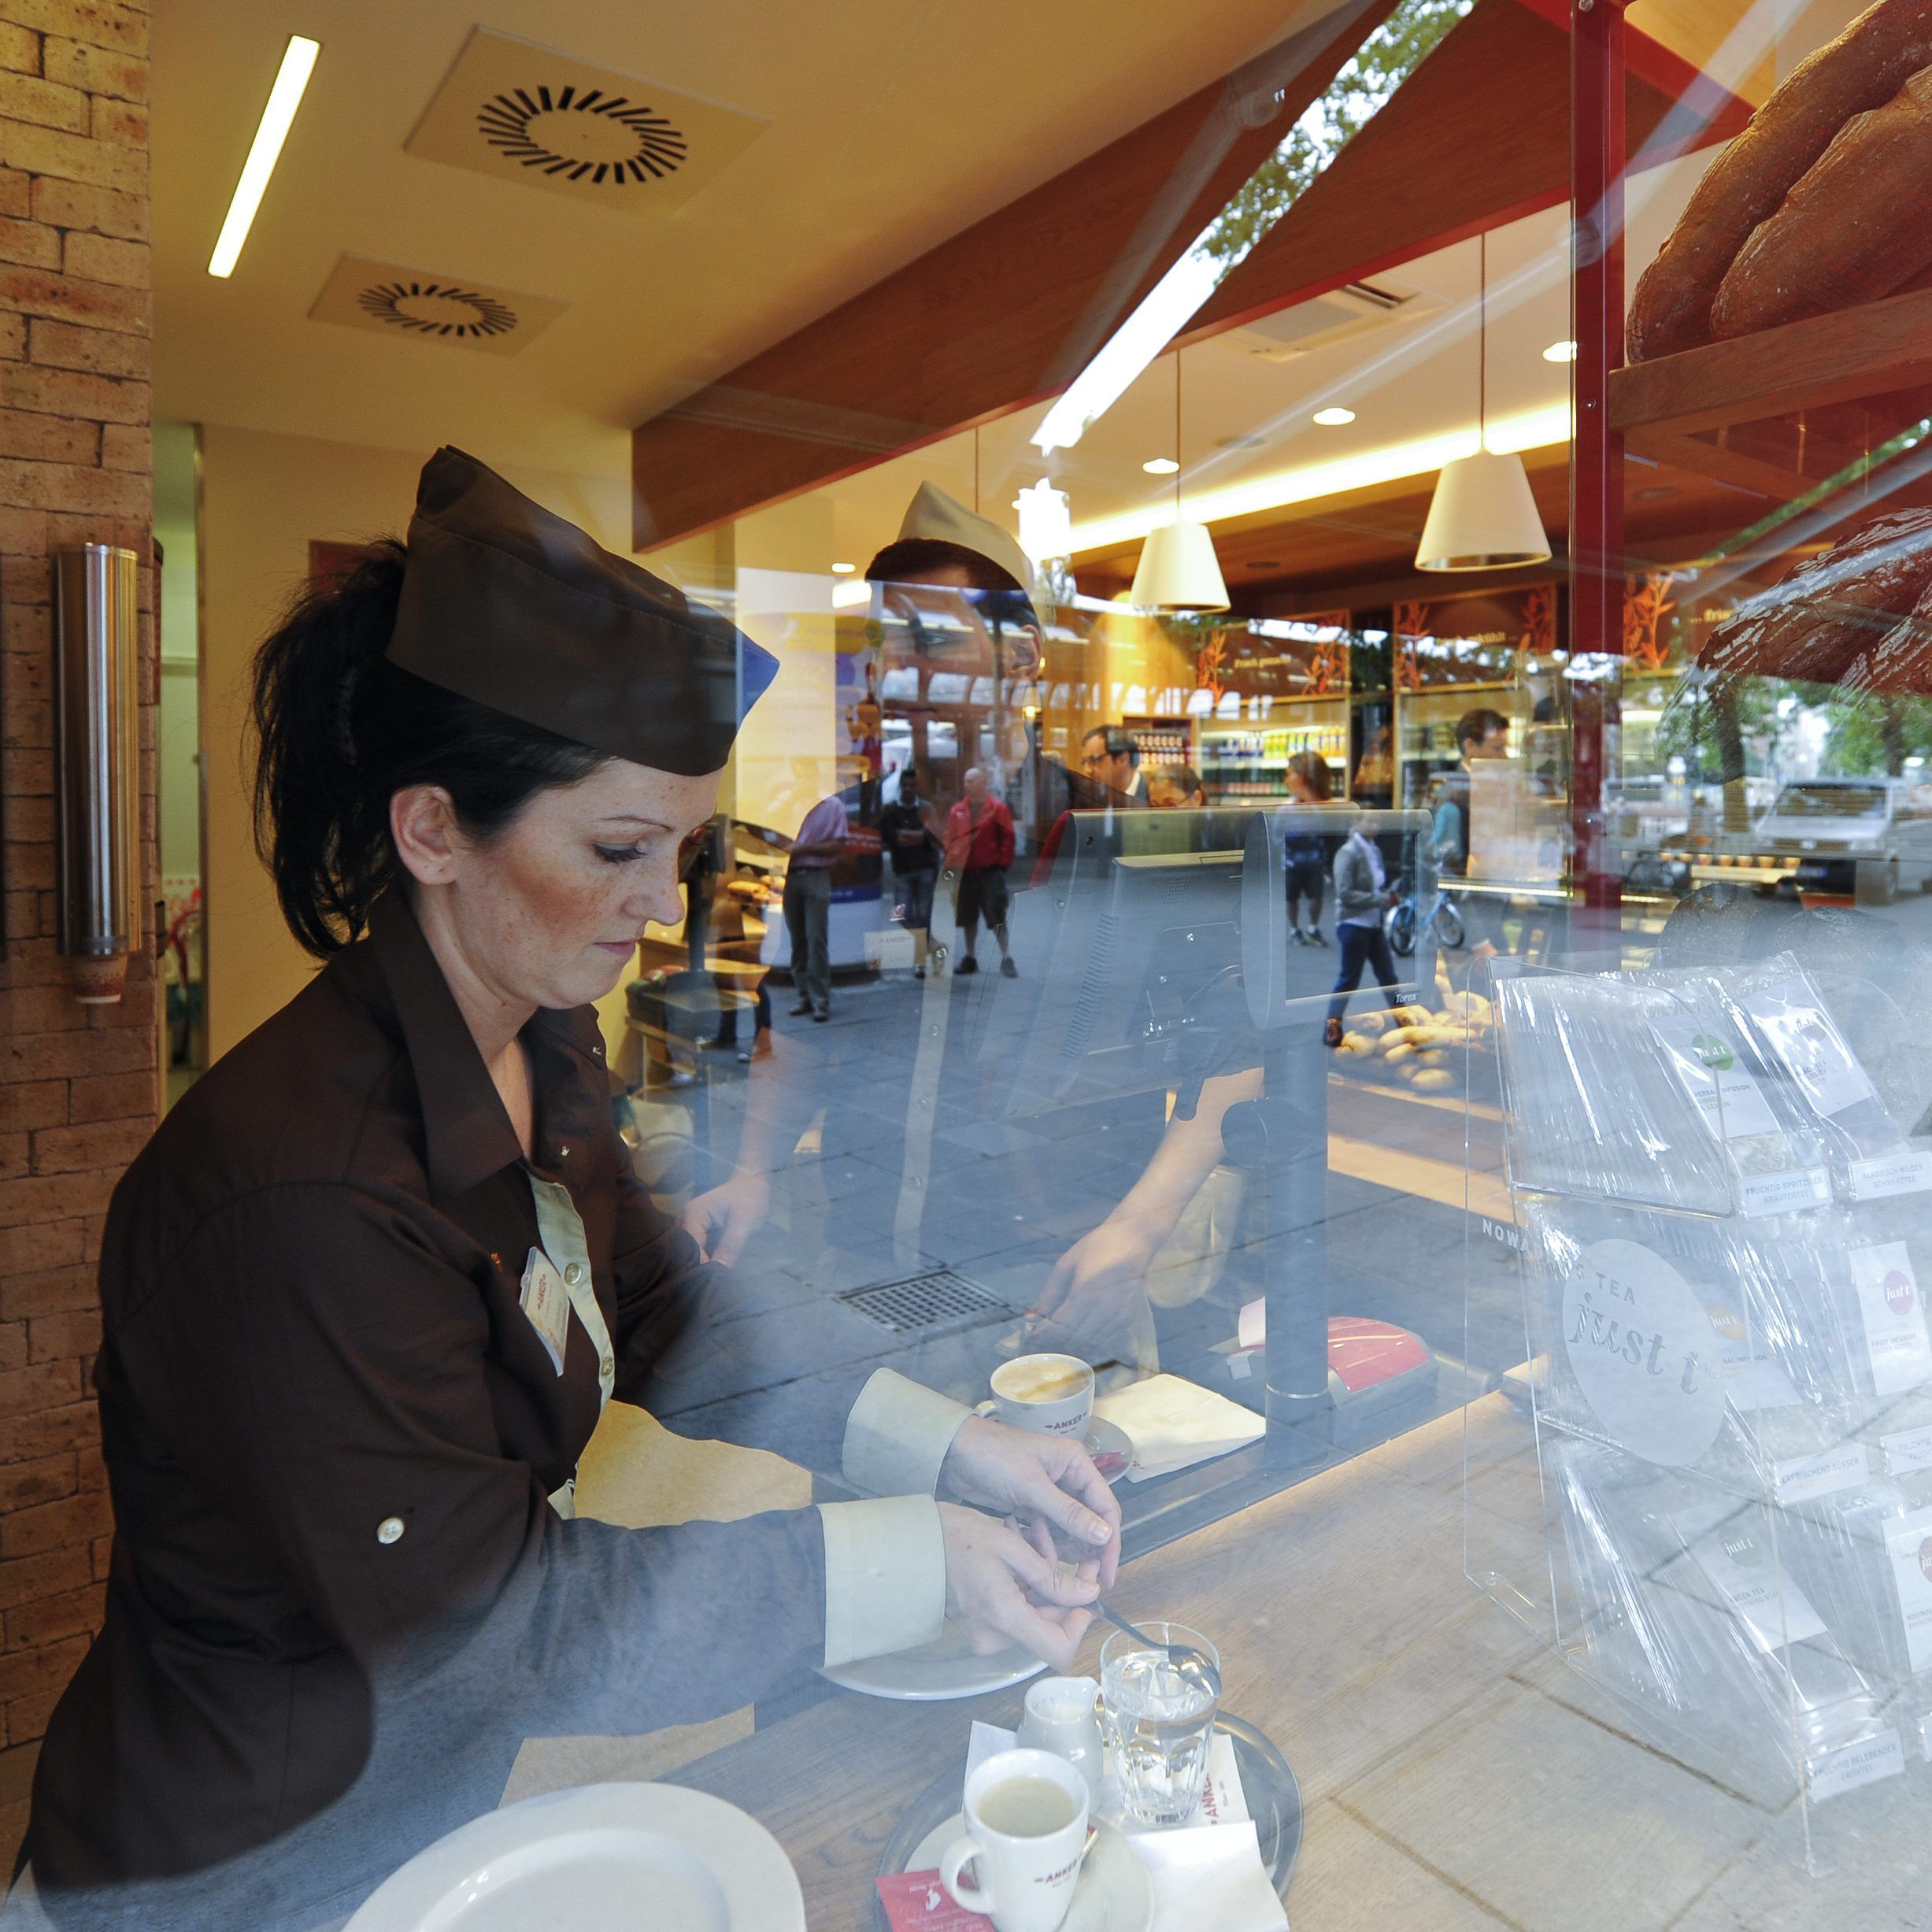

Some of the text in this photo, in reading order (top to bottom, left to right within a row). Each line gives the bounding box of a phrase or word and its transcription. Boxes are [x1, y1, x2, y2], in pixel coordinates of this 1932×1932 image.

[1395, 993, 1418, 1004] Torex
[1596, 1271, 1636, 1306] TEA
[1886, 1286, 1904, 1303] just
[1567, 1291, 1667, 1375] just
[1053, 1414, 1083, 1430] ANKER
[1724, 1538, 1748, 1557] just
[1046, 1858, 1078, 1883] ANKER
